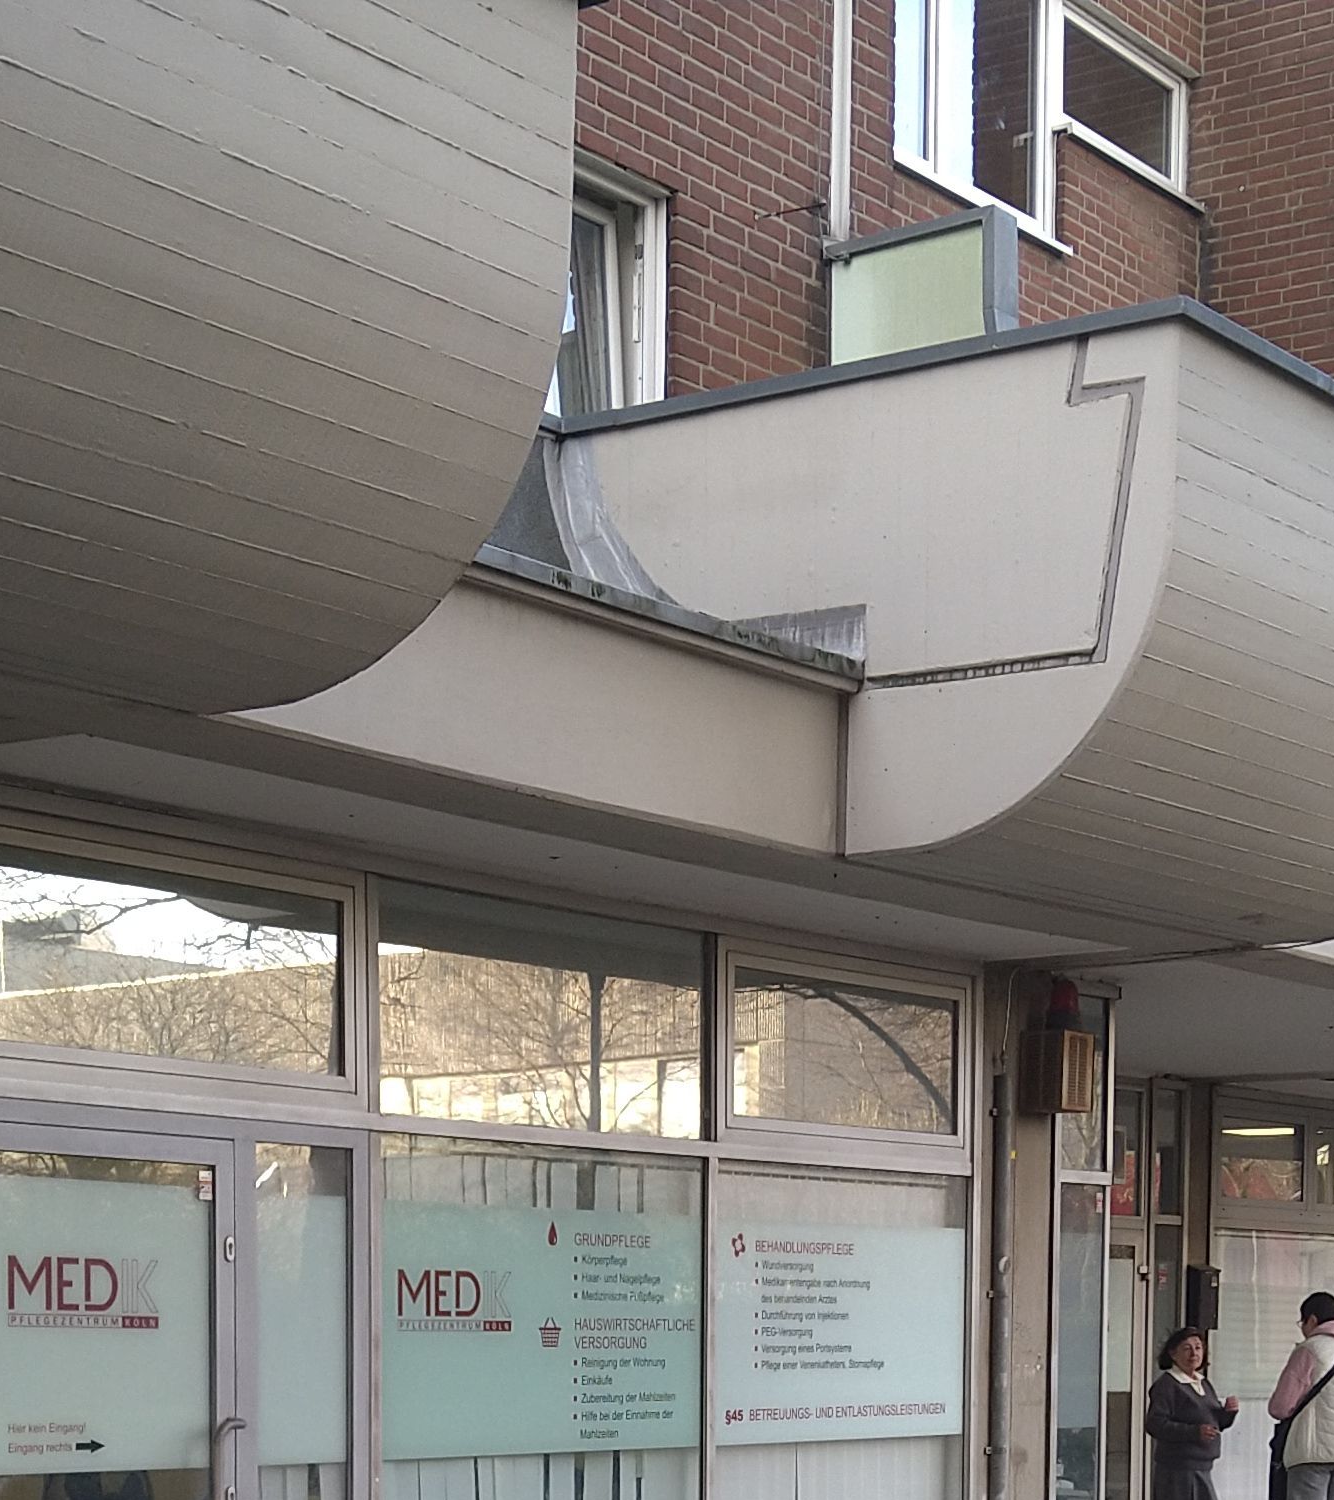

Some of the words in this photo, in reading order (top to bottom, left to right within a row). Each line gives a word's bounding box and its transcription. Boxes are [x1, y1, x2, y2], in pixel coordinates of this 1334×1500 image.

[574, 1233, 651, 1249] GRUNDPFLEGE
[755, 1240, 854, 1256] BEHANDLUNGSPFLEGE
[581, 1255, 628, 1268] Körperpflege
[761, 1260, 814, 1274] Wundversorgung
[581, 1274, 602, 1284] Haar-
[604, 1274, 618, 1284] und
[619, 1274, 661, 1287] Nagelpflege
[823, 1278, 838, 1288] nach
[838, 1278, 871, 1291] Anordnung
[581, 1290, 628, 1301] Medizinische
[761, 1294, 773, 1304] des
[818, 1294, 838, 1304] Arztes
[9, 1315, 119, 1328] PFLEGEZENTRUM
[761, 1310, 804, 1323] Durchführung
[805, 1312, 816, 1320] von
[817, 1311, 850, 1322] Injektionen
[398, 1320, 482, 1331] PFLEGEZENTRUM
[574, 1318, 696, 1332] HAUSWIRTSCHAFTLICHE
[761, 1327, 813, 1339] PEG-Versorgung
[574, 1336, 647, 1350] VERSORGUNG
[761, 1343, 797, 1356] Versorgung
[798, 1345, 815, 1354] eines
[581, 1357, 618, 1370] Reinigung
[619, 1357, 632, 1368] der
[632, 1357, 666, 1369] Wohnung
[761, 1359, 781, 1372] Pflege
[581, 1375, 613, 1386] Einkäufe
[581, 1393, 624, 1405] Zubereitung
[625, 1393, 638, 1402] der
[638, 1391, 676, 1402] Mahlzeiten
[581, 1411, 598, 1422] Hilfe
[599, 1410, 611, 1421] bei
[612, 1410, 624, 1421] der
[625, 1409, 660, 1421] Einnahme
[661, 1410, 674, 1419] der
[724, 1409, 744, 1425] §45
[749, 1406, 814, 1422] BETREUUNGS-
[815, 1406, 834, 1419] UND
[835, 1402, 946, 1419] ENTLASTUNGSLEISTUNGEN
[8, 1423, 27, 1434] Hier
[28, 1422, 47, 1434] kein
[48, 1421, 87, 1435] Eingang!
[580, 1428, 619, 1440] Mahlzeiten
[8, 1442, 44, 1456] Eingang
[46, 1442, 73, 1453] rechts
